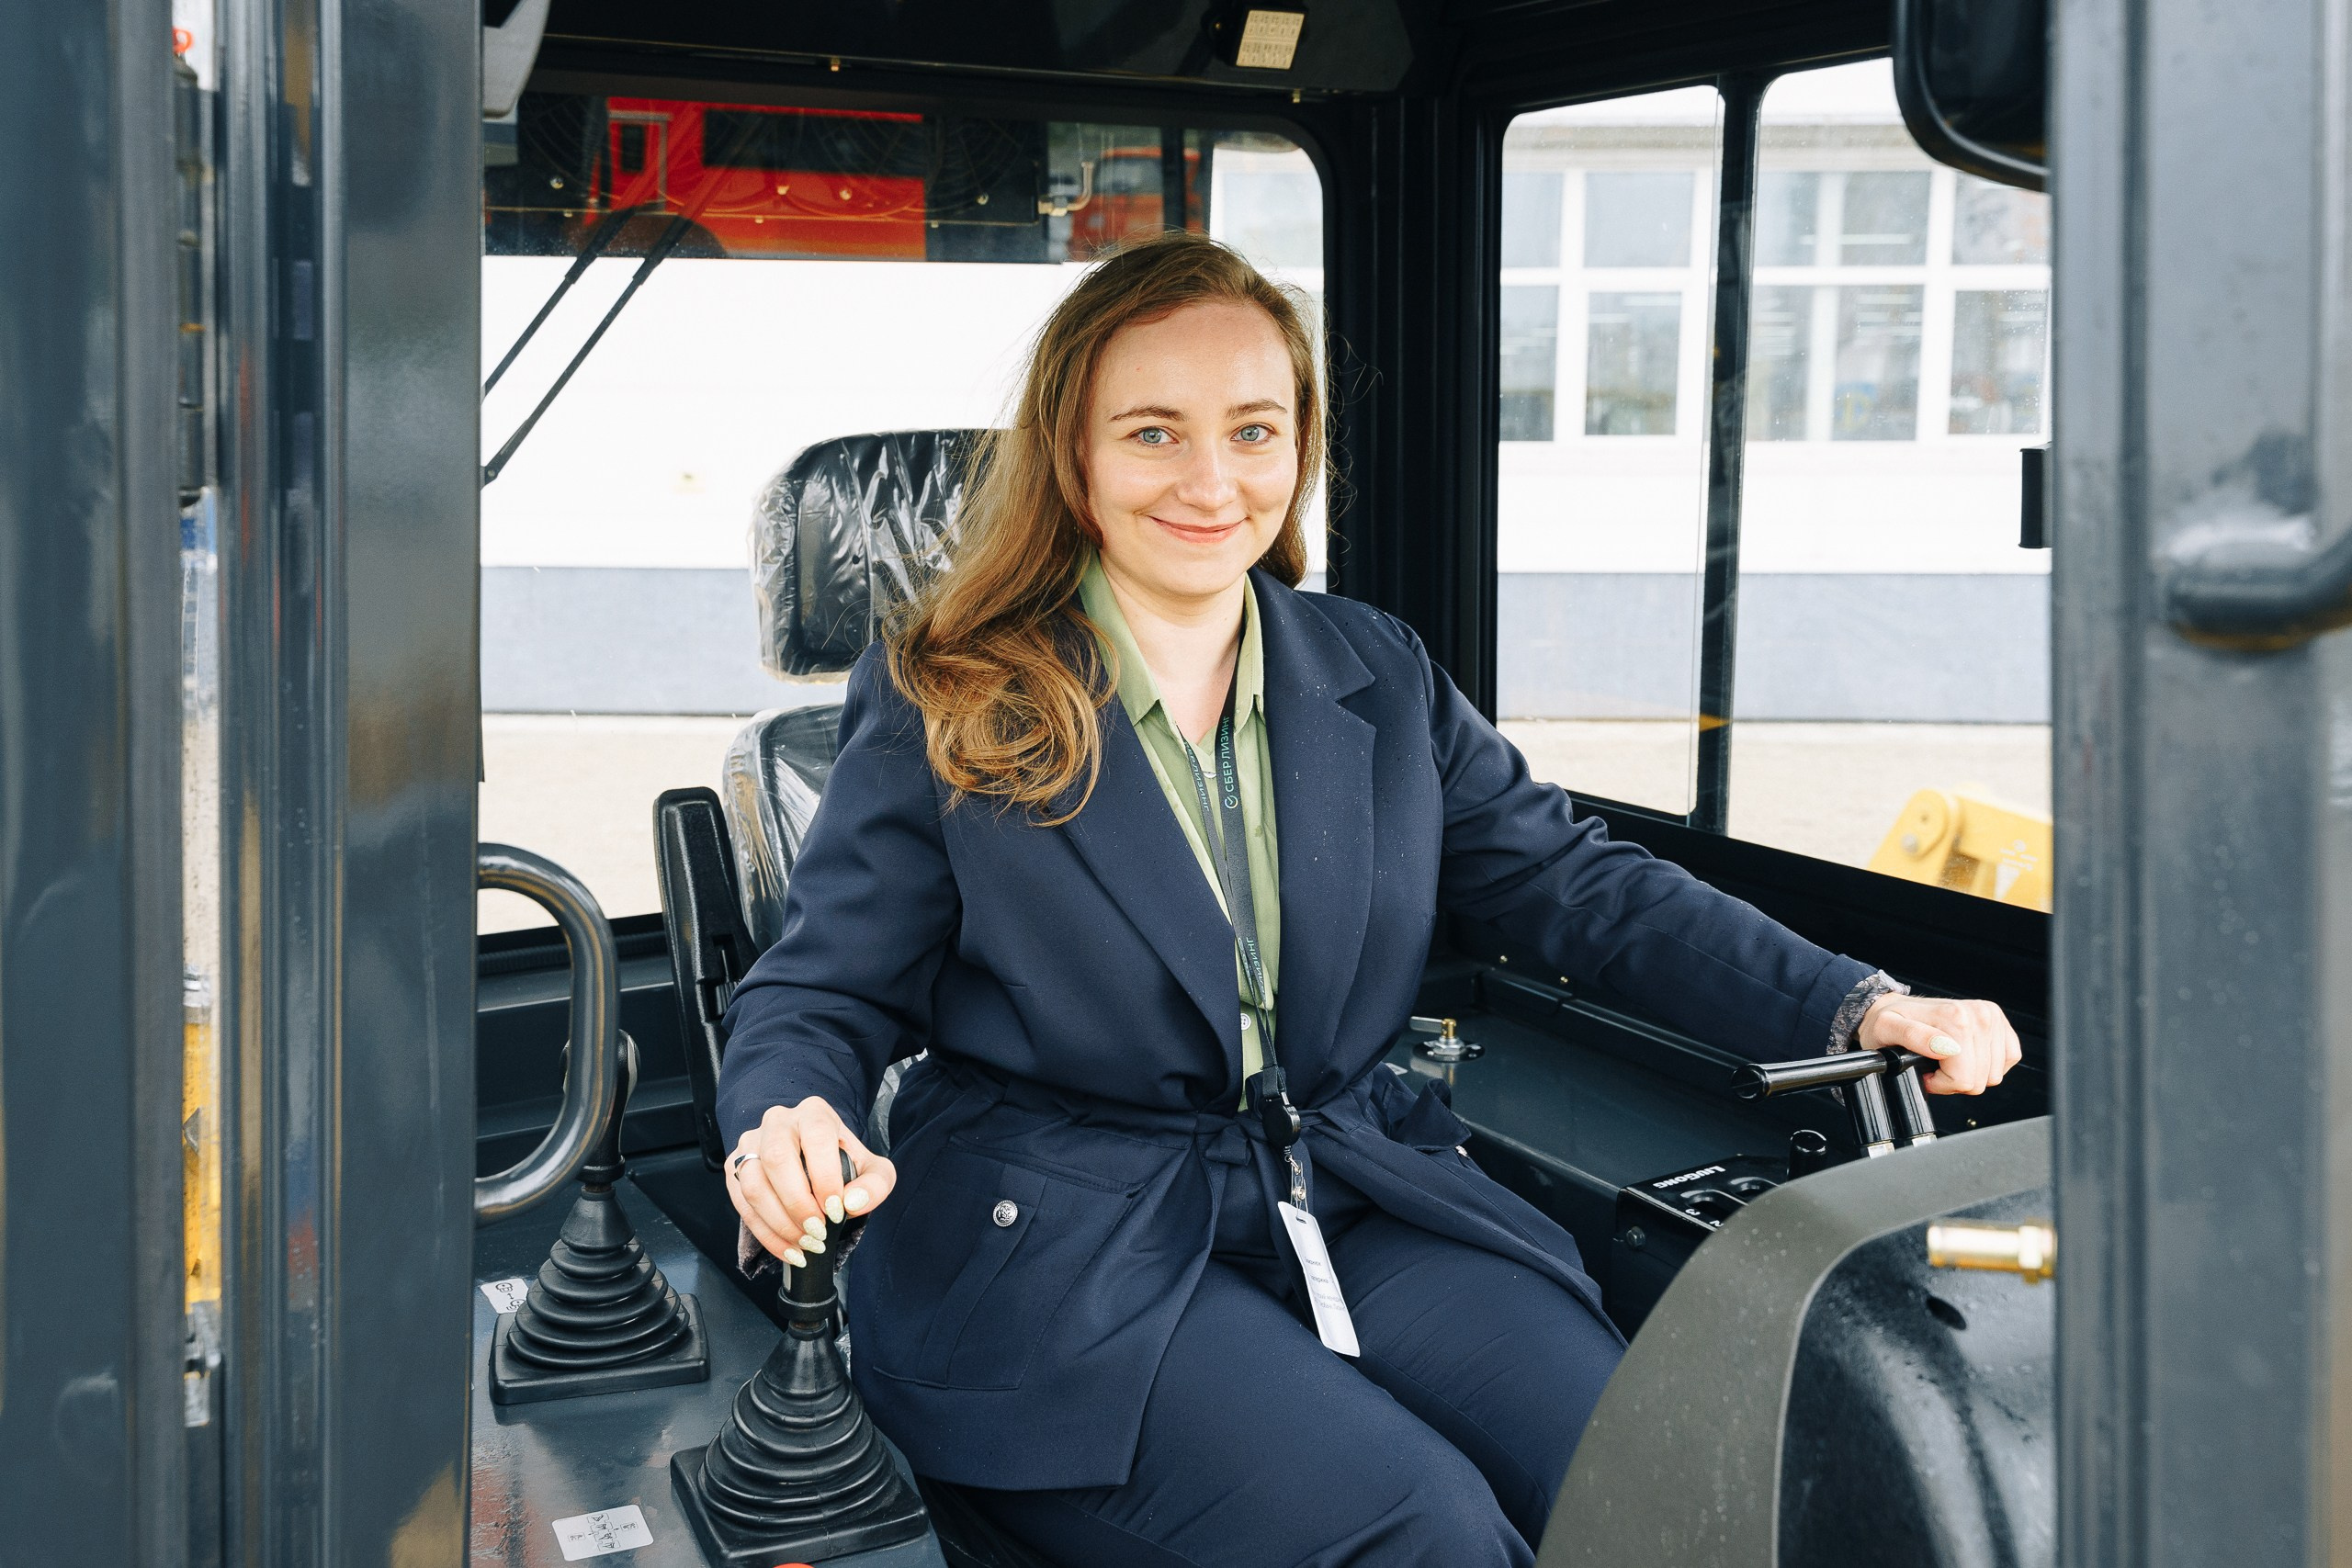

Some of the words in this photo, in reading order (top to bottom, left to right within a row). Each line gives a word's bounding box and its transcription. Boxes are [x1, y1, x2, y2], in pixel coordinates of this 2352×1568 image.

[1221, 716, 1231, 760] ЛИЗИНГ
[1193, 763, 1210, 812] ЛИЗИНГ
[1222, 761, 1235, 793] СБЕР
[1685, 1208, 1701, 1216] 3
